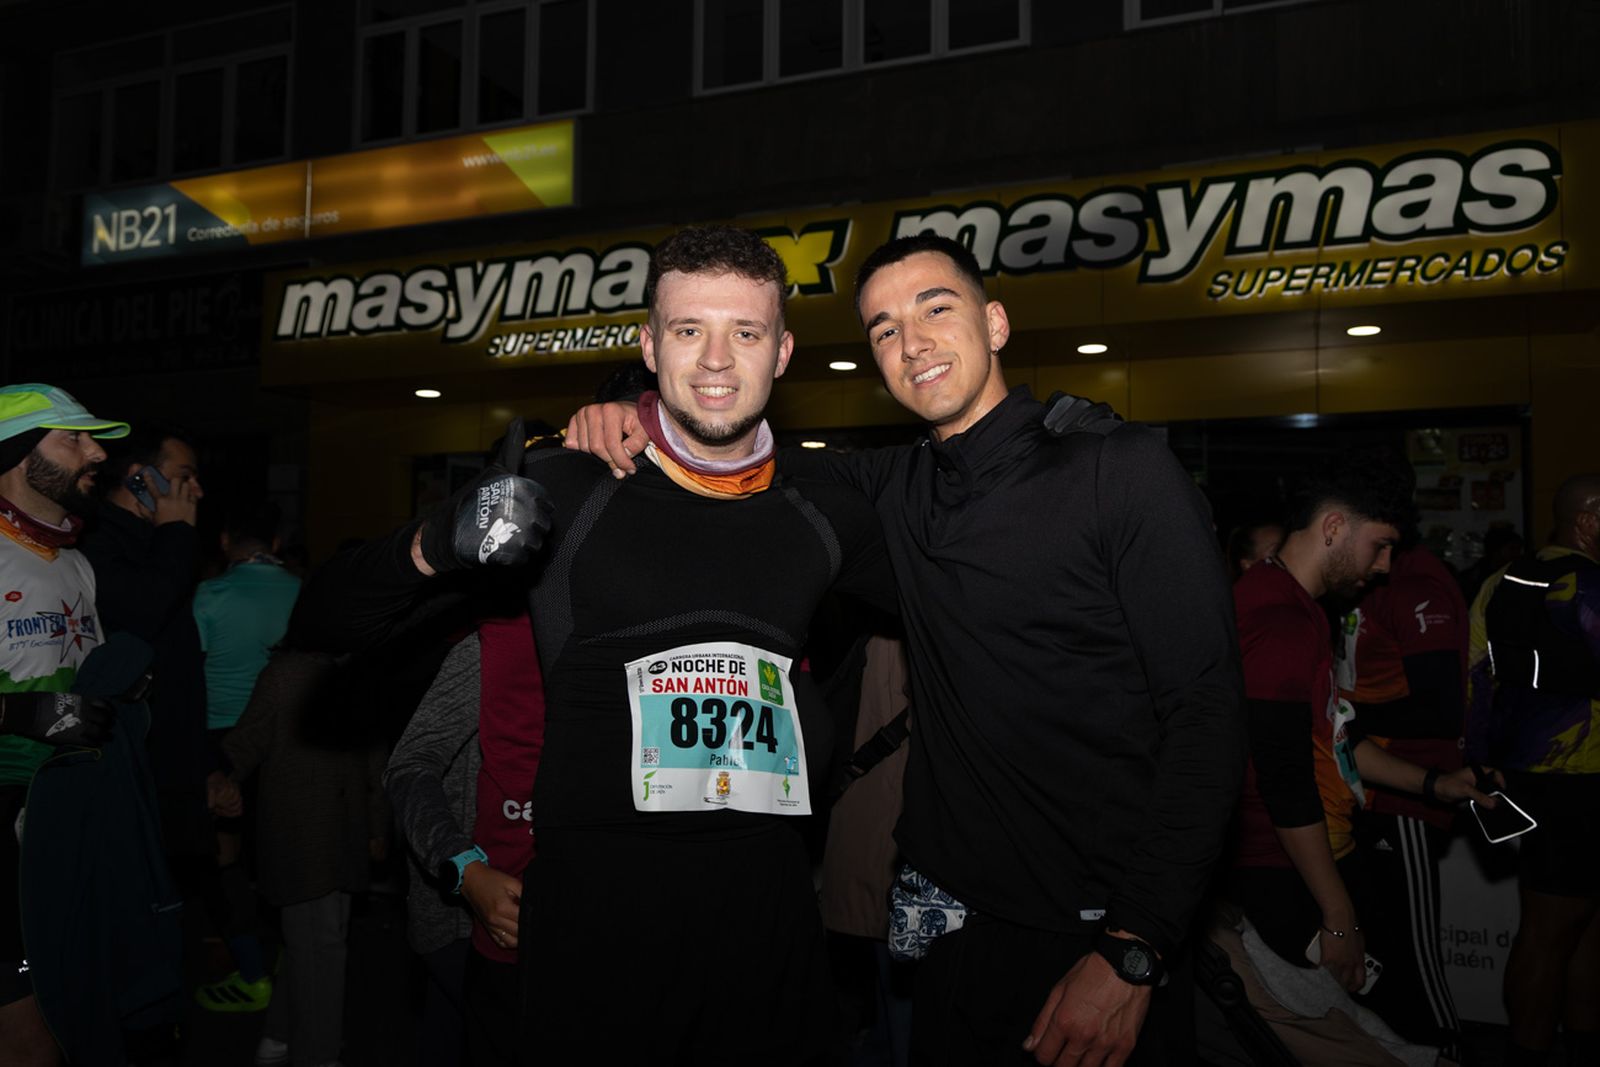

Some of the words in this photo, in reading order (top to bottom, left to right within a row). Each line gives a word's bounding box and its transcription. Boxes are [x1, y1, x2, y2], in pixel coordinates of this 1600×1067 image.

[262, 216, 280, 231] de
[895, 147, 1552, 277] masymas
[92, 203, 177, 254] NB21
[1207, 241, 1568, 300] SUPERMERCADOS
[277, 246, 652, 340] masyma
[167, 288, 211, 337] PIE
[488, 321, 641, 358] SUPERMERC
[490, 482, 500, 505] SAN
[482, 535, 496, 553] 43
[671, 659, 726, 674] NOCHE
[728, 660, 746, 676] DE
[651, 677, 688, 693] SAN
[693, 675, 748, 697] ANTÓN
[670, 697, 779, 754] 8324
[1496, 929, 1510, 948] d
[1442, 948, 1494, 970] Jaén
